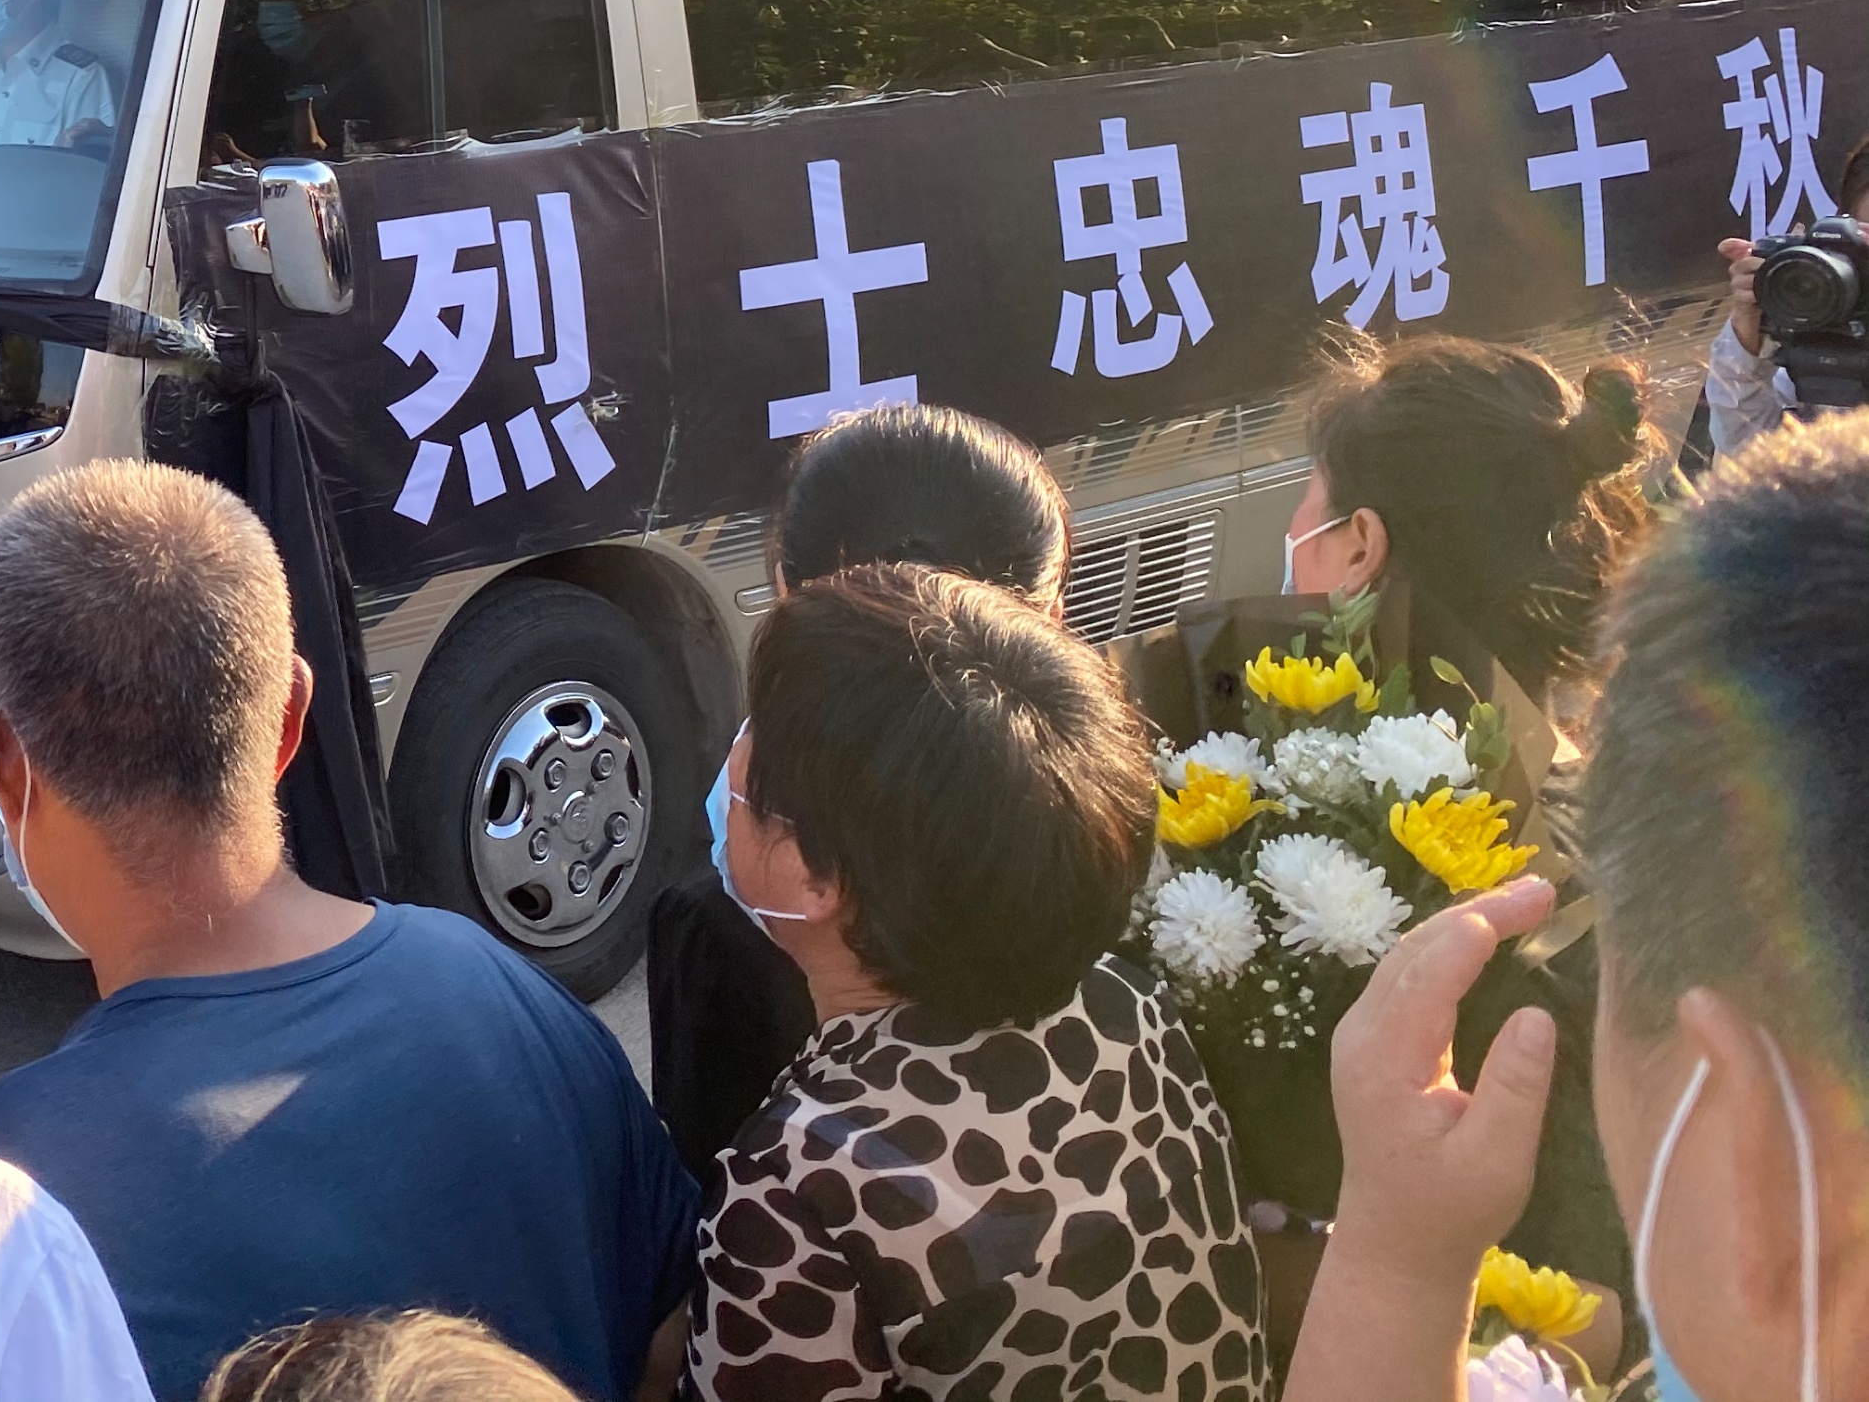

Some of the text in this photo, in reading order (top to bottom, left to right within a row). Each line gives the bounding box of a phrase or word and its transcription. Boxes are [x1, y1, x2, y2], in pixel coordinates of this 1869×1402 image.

[377, 28, 1839, 524] 烈士忠魂千秋
